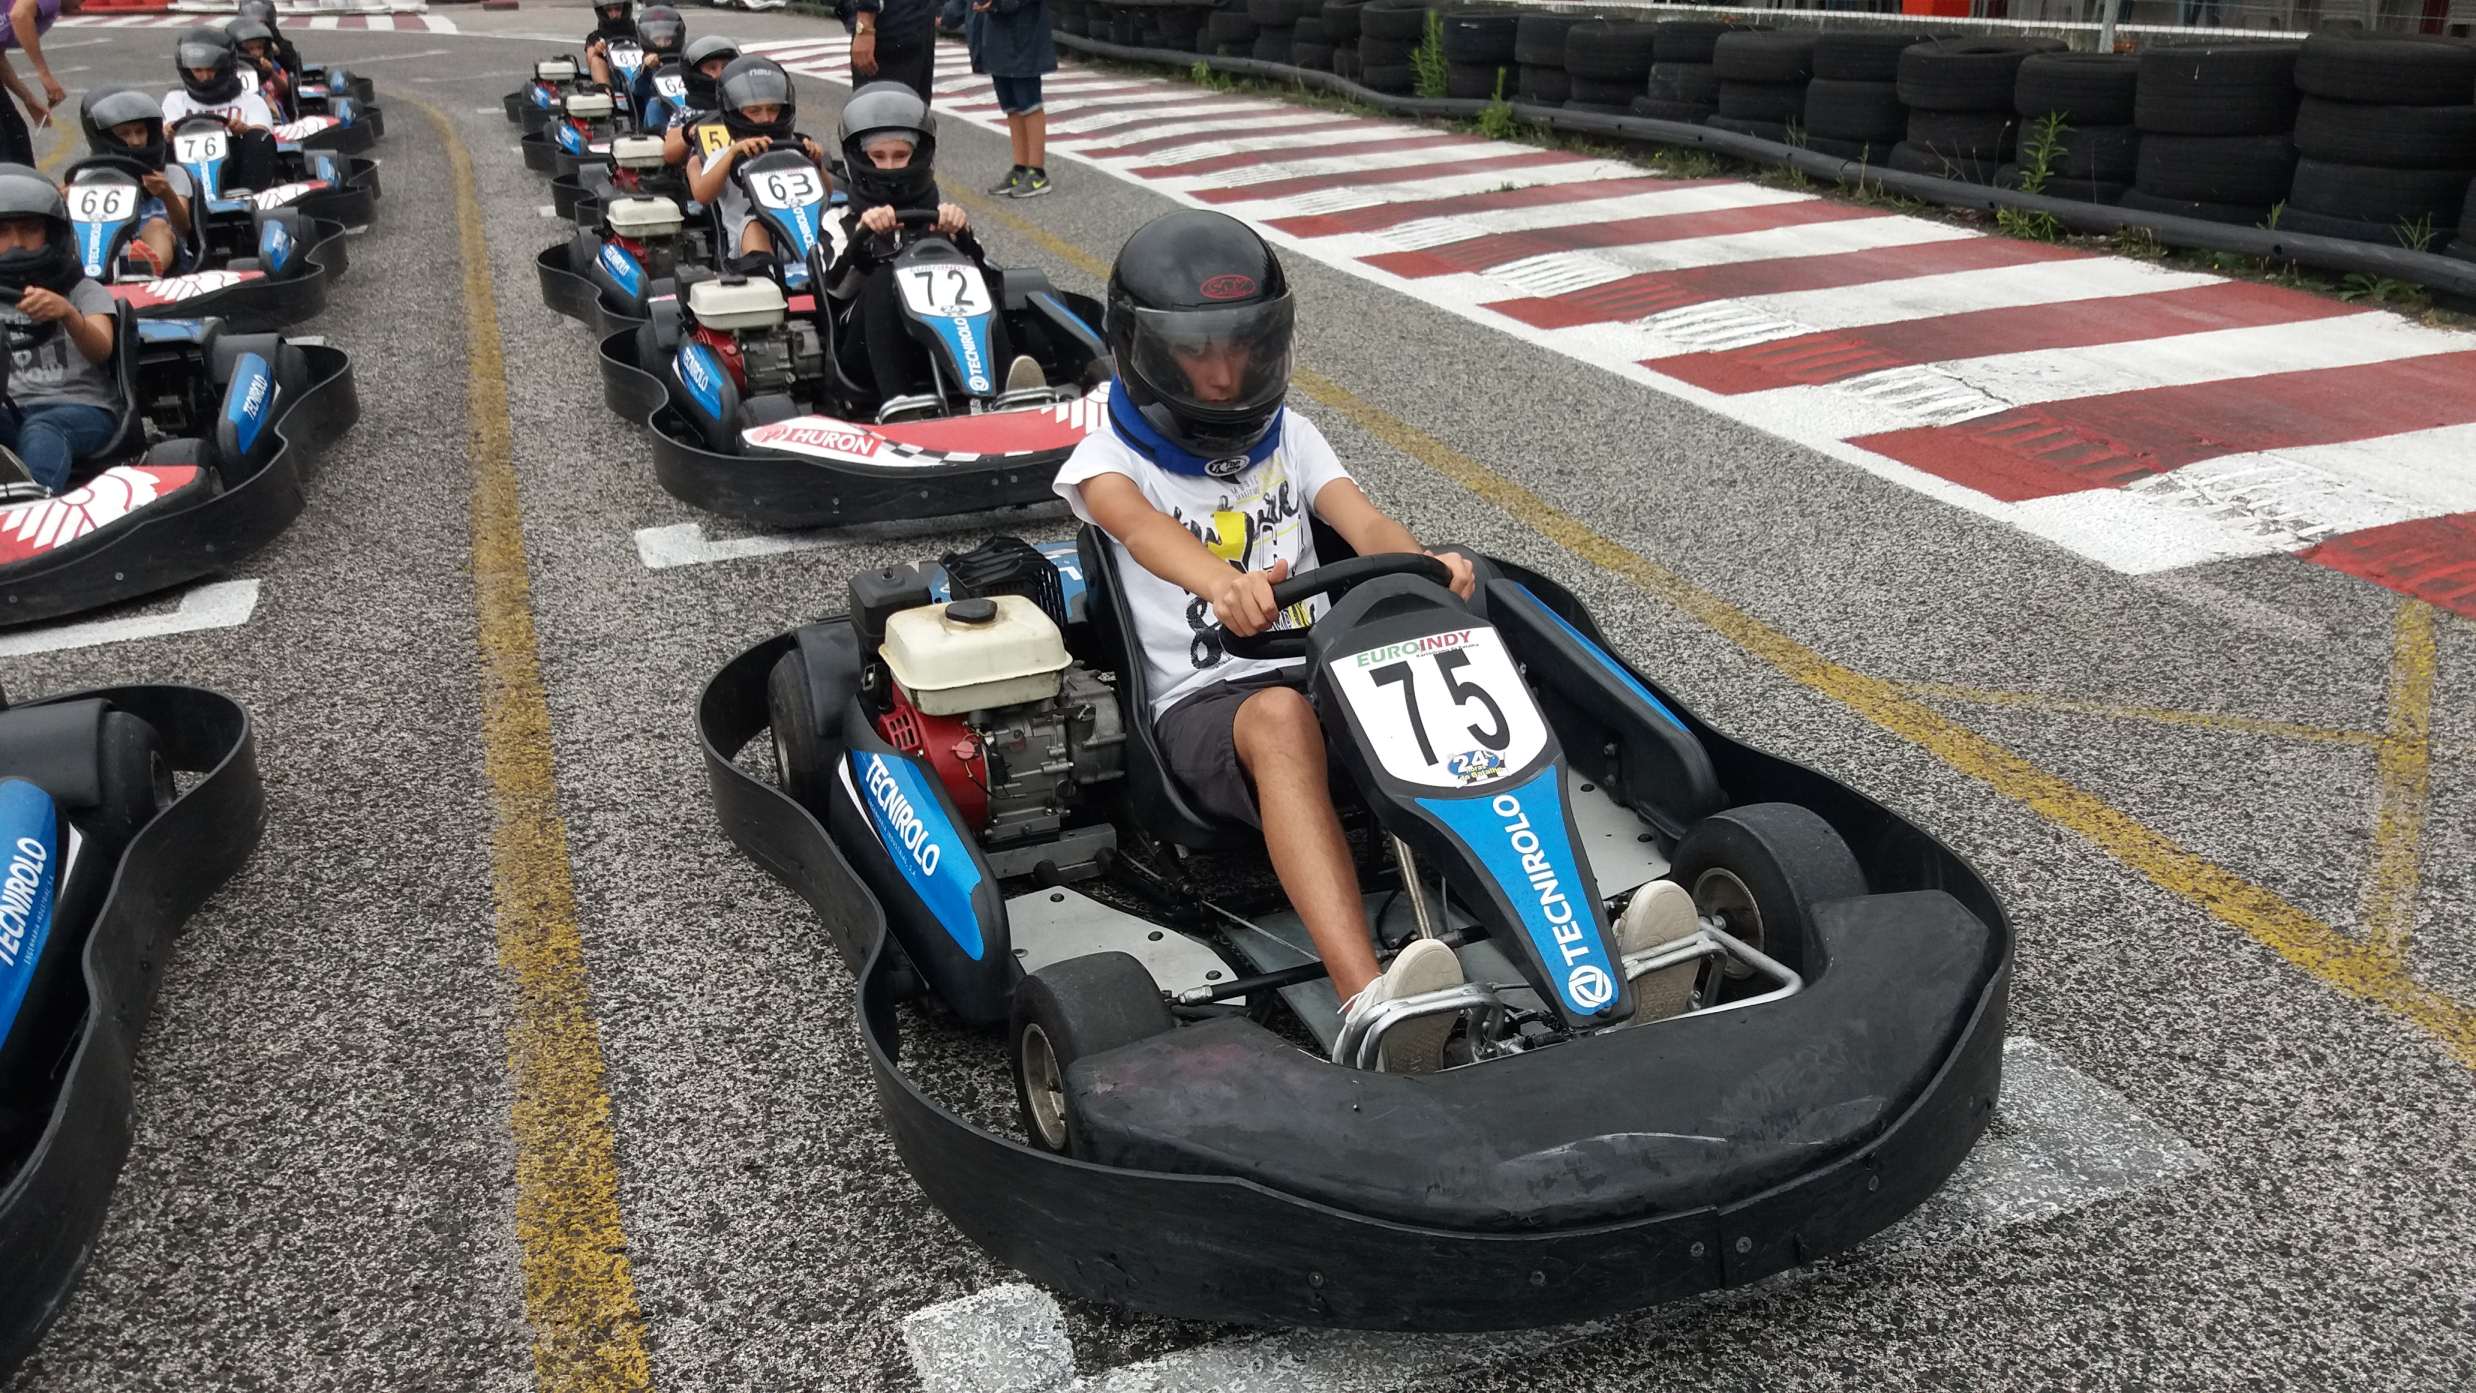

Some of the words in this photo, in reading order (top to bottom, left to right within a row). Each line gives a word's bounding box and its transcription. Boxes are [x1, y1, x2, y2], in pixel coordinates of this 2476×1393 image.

[184, 137, 216, 158] 76
[81, 190, 121, 215] 66
[768, 173, 813, 201] 63
[914, 269, 975, 306] 72
[954, 317, 983, 375] TECNIROLO
[791, 428, 875, 455] HURON
[1368, 648, 1511, 767] 75
[1453, 750, 1490, 773] 24
[866, 753, 941, 877] TECNIROLO
[1492, 794, 1591, 967] TECNIROLO
